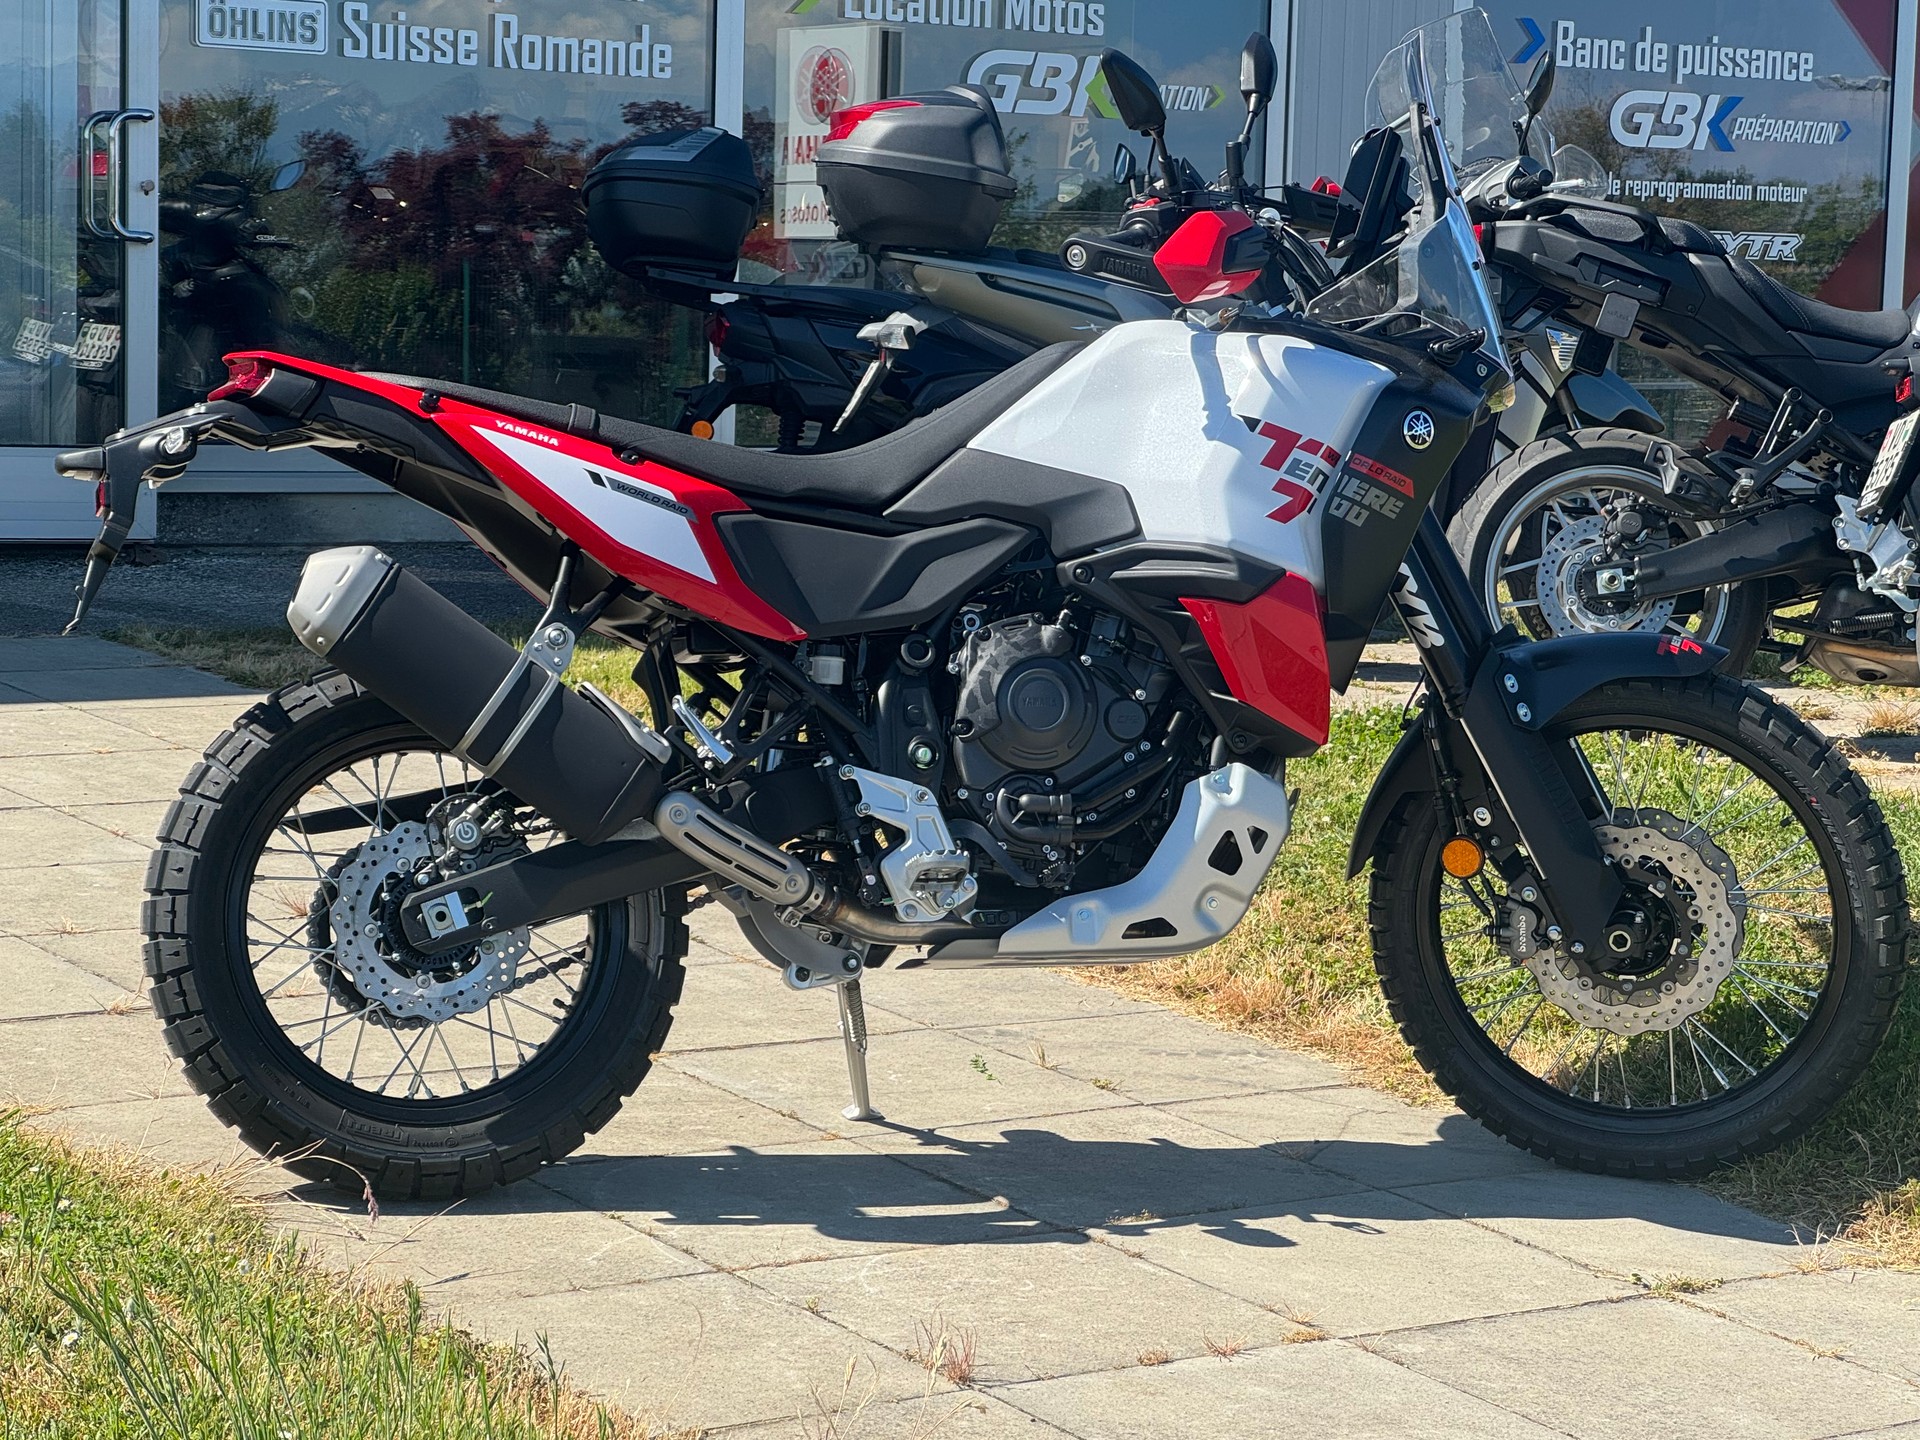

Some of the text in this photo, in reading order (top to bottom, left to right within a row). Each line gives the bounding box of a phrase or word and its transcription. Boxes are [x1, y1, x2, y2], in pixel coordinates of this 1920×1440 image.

[1005, 0, 1104, 36] Motos
[343, 1, 672, 79] Suisse Romande
[1556, 20, 1814, 84] Banc de puissance
[1610, 90, 1840, 152] GBK PRÉPARATION
[1625, 177, 1752, 203] reprogrammation
[1756, 182, 1808, 203] moteur
[1102, 257, 1147, 280] YAMAHA
[495, 419, 559, 447] YAMAHA
[1382, 472, 1408, 488] RAID
[616, 482, 689, 515] WORLD RAID
[1517, 914, 1527, 953] brembo
